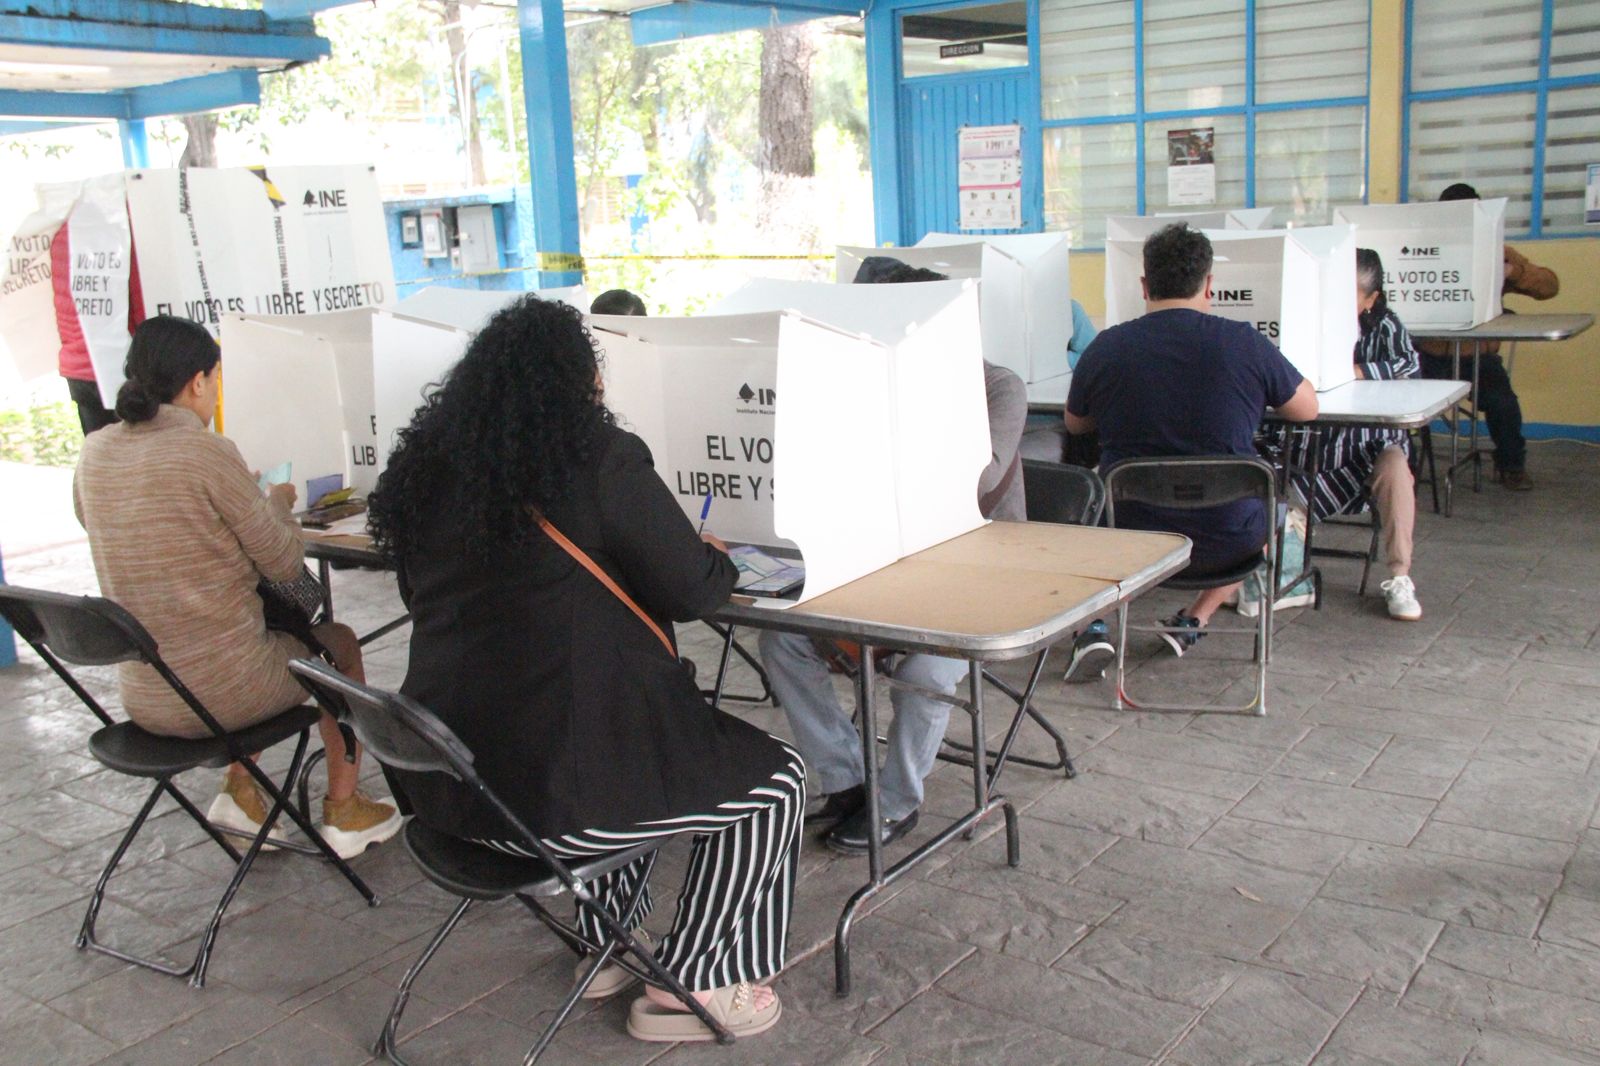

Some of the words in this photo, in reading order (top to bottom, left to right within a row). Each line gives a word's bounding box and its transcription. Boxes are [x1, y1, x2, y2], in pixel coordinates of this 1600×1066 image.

[318, 189, 347, 208] INE
[1413, 247, 1440, 256] INE
[72, 275, 100, 292] IBRE
[102, 275, 111, 292] Y
[1399, 271, 1437, 284] VOTO
[1441, 270, 1460, 284] ES
[323, 281, 385, 312] SECRETO
[1218, 289, 1253, 301] INE
[1401, 289, 1410, 302] Y
[352, 445, 377, 466] LIB
[706, 435, 736, 461] EL
[739, 436, 775, 464] VO
[676, 471, 742, 499] LIBRE
[747, 475, 762, 501] Y
